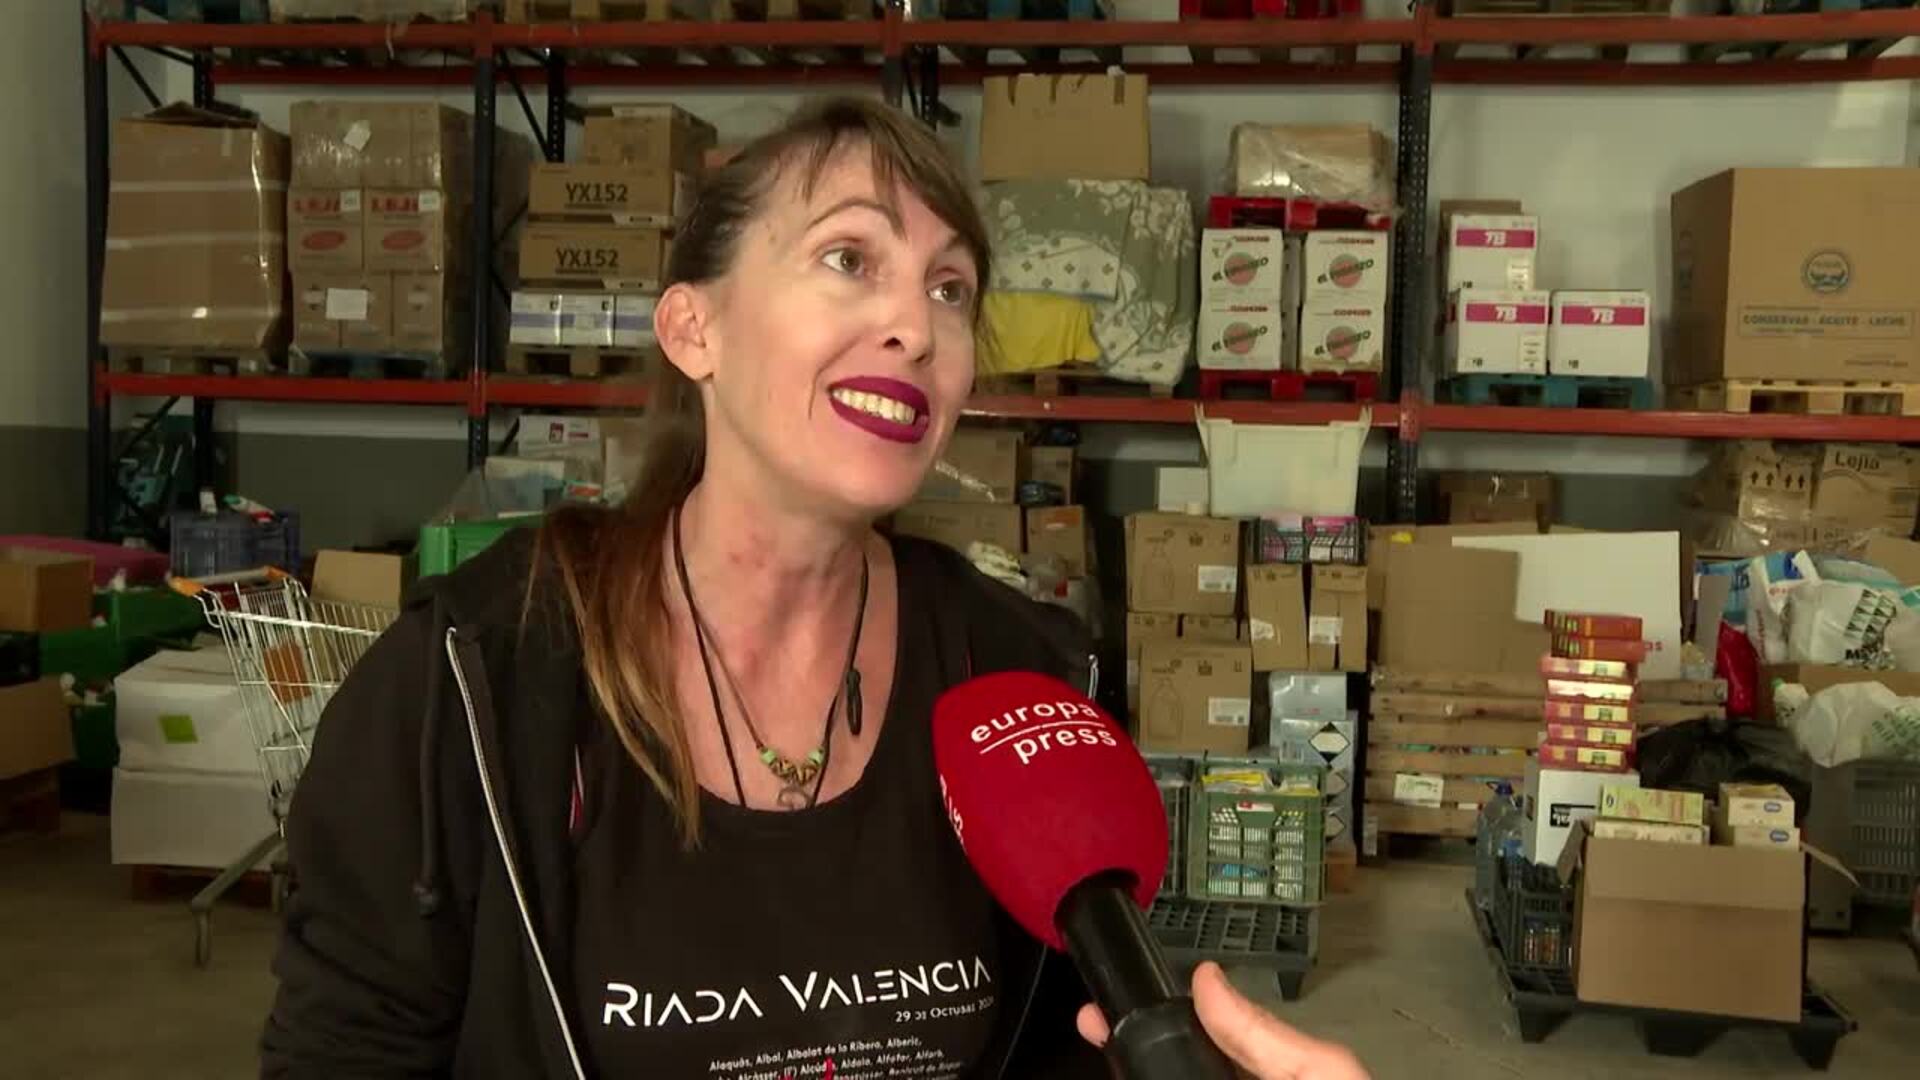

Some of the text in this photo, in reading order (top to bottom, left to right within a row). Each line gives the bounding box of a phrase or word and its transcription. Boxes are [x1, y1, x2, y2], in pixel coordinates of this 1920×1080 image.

[565, 182, 628, 202] YX152
[556, 248, 618, 268] YX152
[970, 701, 1100, 743] europa
[1013, 728, 1117, 765] press
[778, 955, 992, 1012] VALENCIA
[896, 1010, 911, 1022] 29
[824, 1044, 836, 1056] de
[838, 1043, 848, 1053] la
